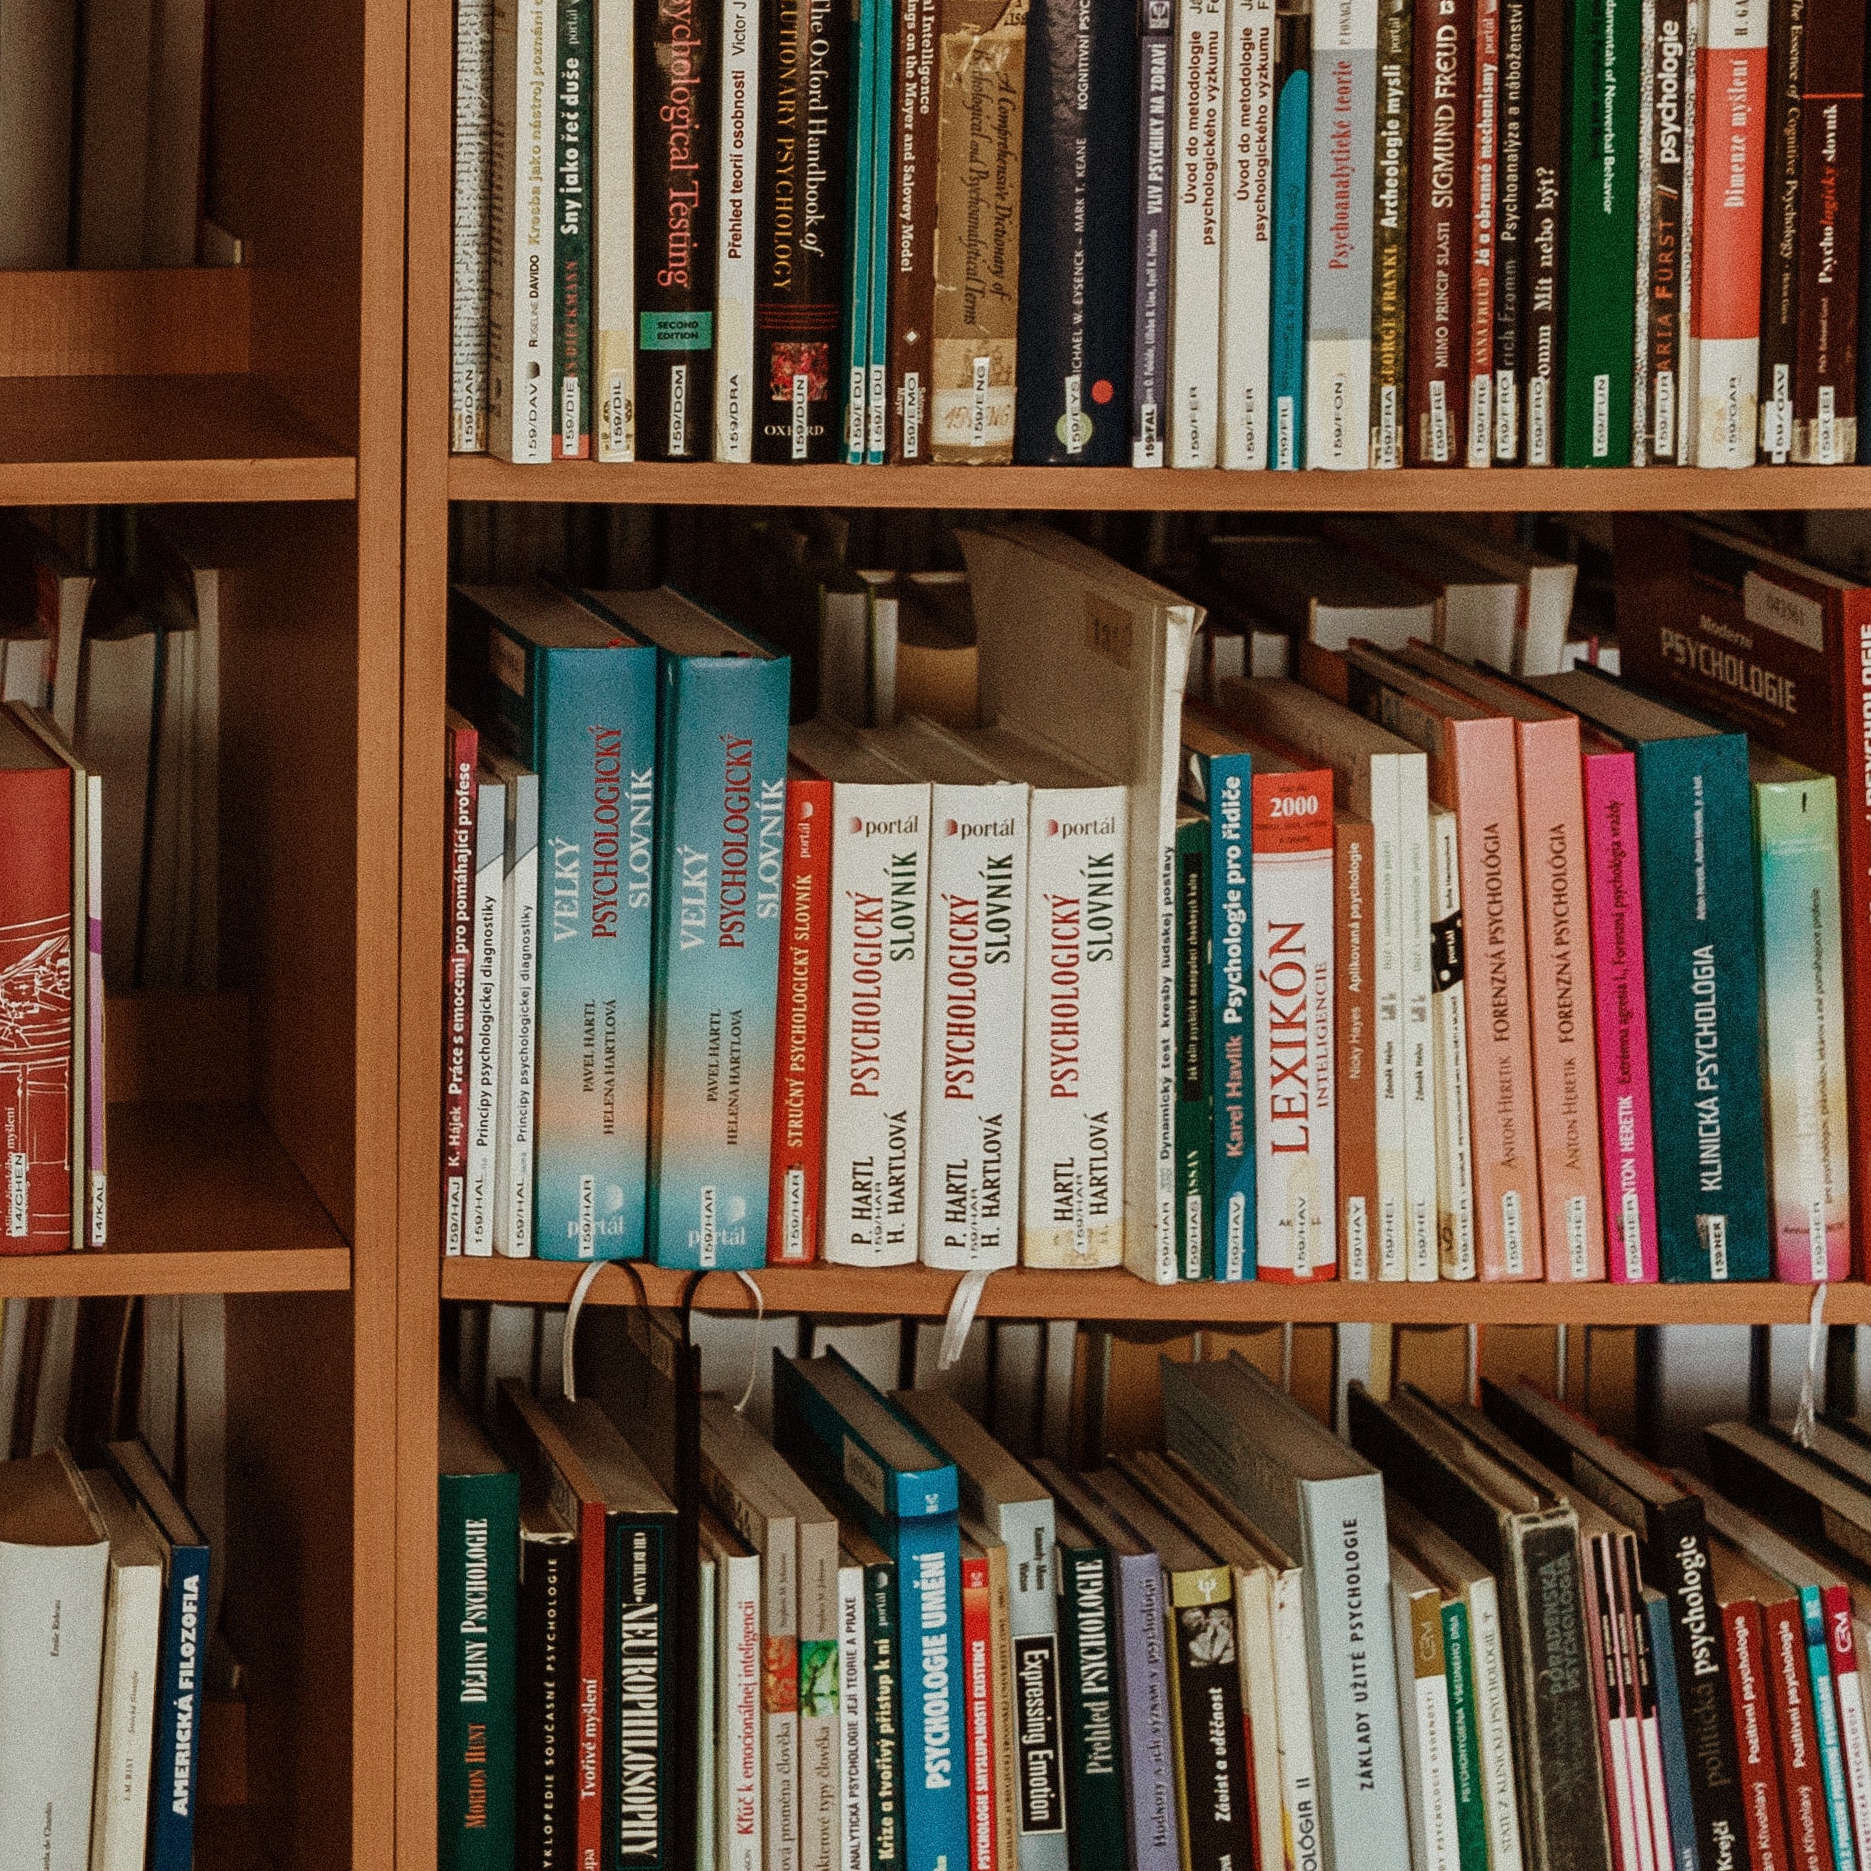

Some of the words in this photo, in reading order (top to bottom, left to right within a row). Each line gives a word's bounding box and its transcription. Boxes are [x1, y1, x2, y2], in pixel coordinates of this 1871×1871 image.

[1728, 58, 1749, 126] myšlení
[1724, 133, 1745, 207] Dimenze
[658, 179, 699, 288] Testing
[775, 135, 794, 291] PSYCHOLOGY
[657, 320, 699, 330] SECOND
[658, 331, 699, 340] EDITION
[864, 815, 918, 838] portál
[1269, 796, 1318, 818] 2000
[891, 850, 916, 962] SLOVNÍK
[852, 892, 883, 1098] PSYCHOLOGICKÝ
[1268, 919, 1308, 1156] LEXIKÓN
[919, 1550, 945, 1630] UMĚNÍ
[1682, 1535, 1718, 1677] psychologie
[924, 1637, 948, 1789] PSYCHOLOGIE
[1022, 1648, 1050, 1737] Expressing
[1027, 1745, 1052, 1821] Emotion
